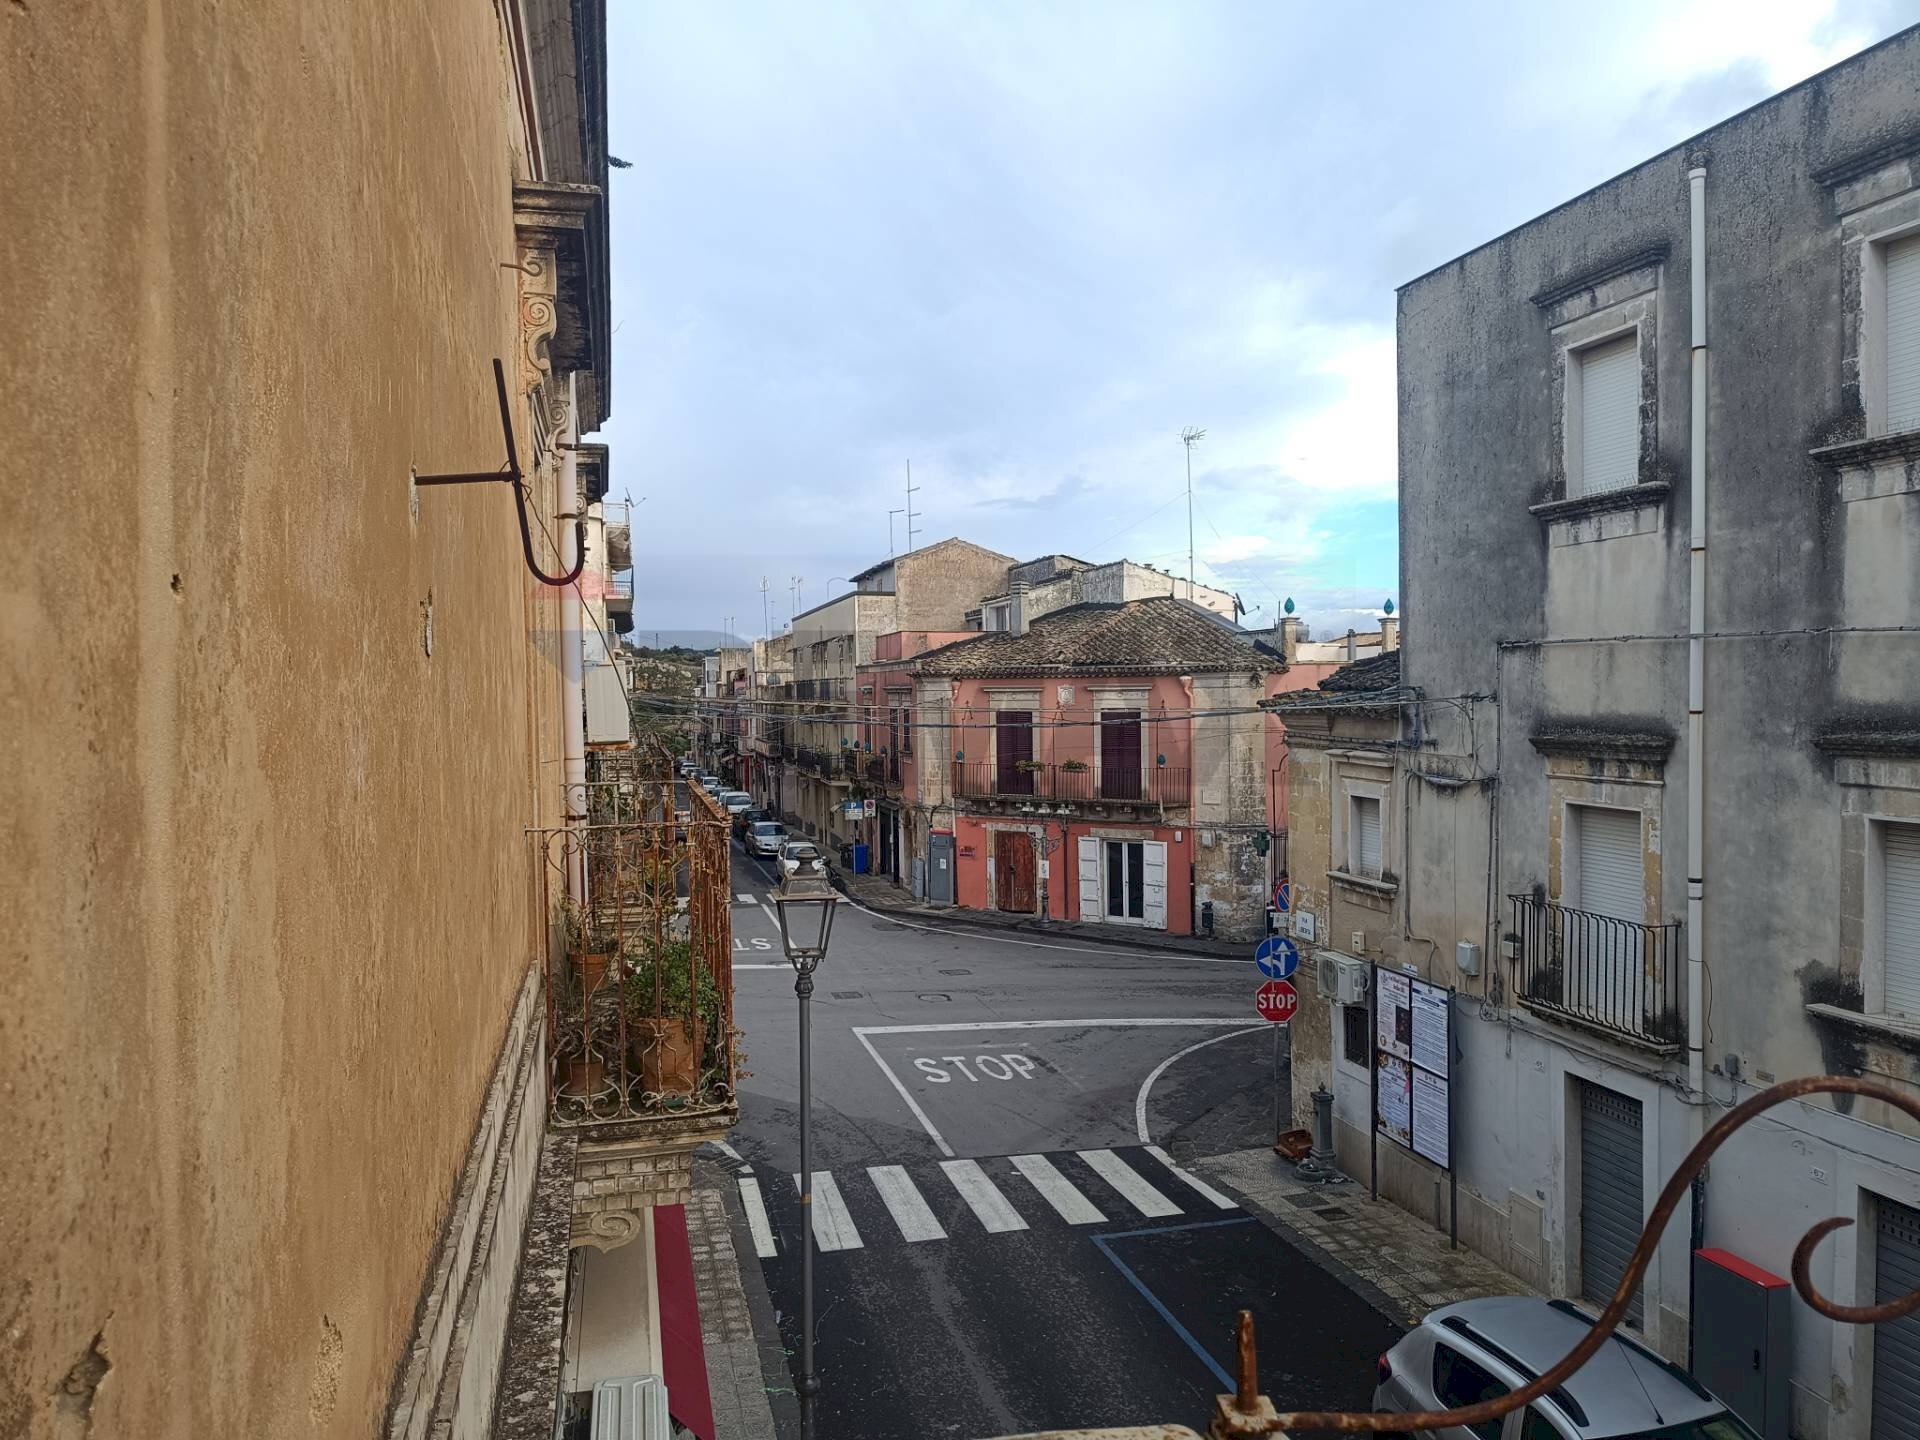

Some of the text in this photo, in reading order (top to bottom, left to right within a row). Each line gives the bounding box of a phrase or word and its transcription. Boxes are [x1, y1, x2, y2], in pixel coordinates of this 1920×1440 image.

[732, 937, 771, 951] ST
[1258, 993, 1296, 1009] STOP
[913, 1054, 1036, 1083] STOP
